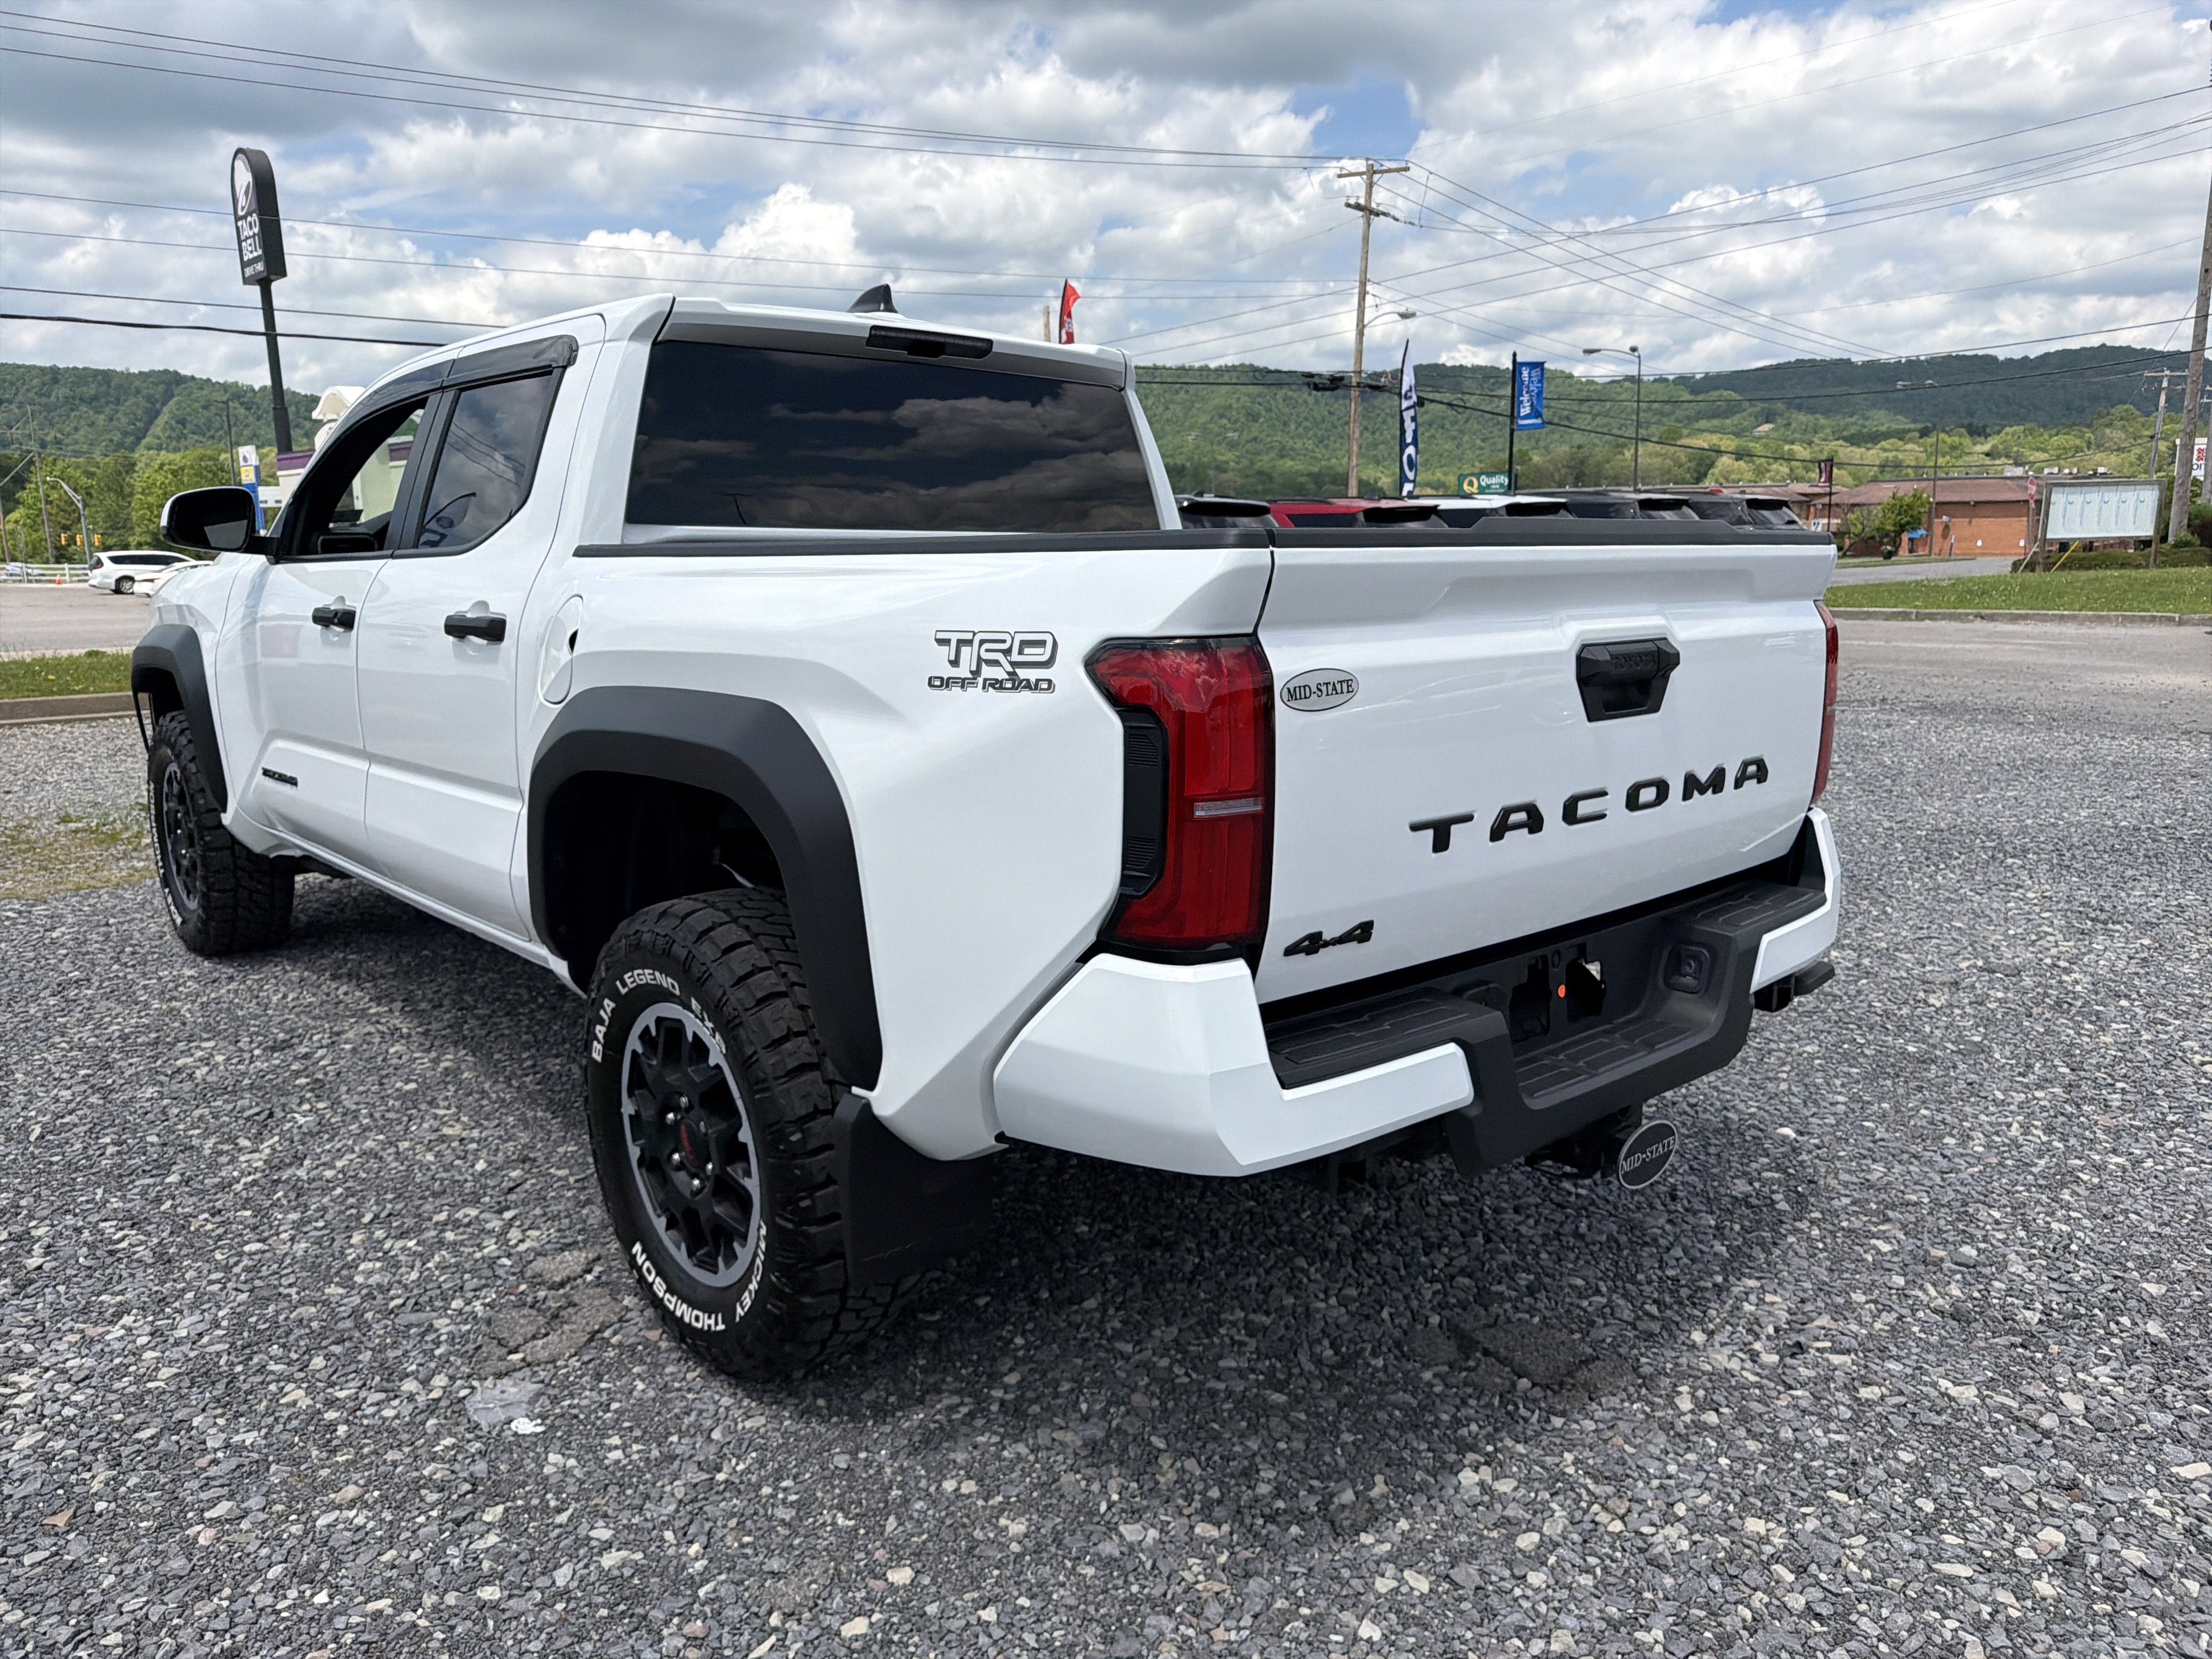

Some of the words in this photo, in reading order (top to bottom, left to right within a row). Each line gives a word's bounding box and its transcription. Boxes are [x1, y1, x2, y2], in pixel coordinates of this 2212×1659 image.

[237, 213, 259, 240] TACO
[242, 235, 262, 261] BELL
[1519, 366, 1531, 417] Welcome
[1480, 475, 1509, 487] Quality
[934, 630, 1058, 679] TRD
[928, 676, 978, 692] OFF
[981, 678, 1056, 694] ROAD
[1286, 679, 1354, 702] MID-STATE
[1409, 755, 1769, 854] TACOMA
[592, 997, 617, 1063] BAJA
[616, 969, 680, 996] LEGEND
[691, 996, 726, 1054] EXP
[631, 1240, 726, 1331] THOMPSON
[735, 1219, 767, 1323] MICKEY
